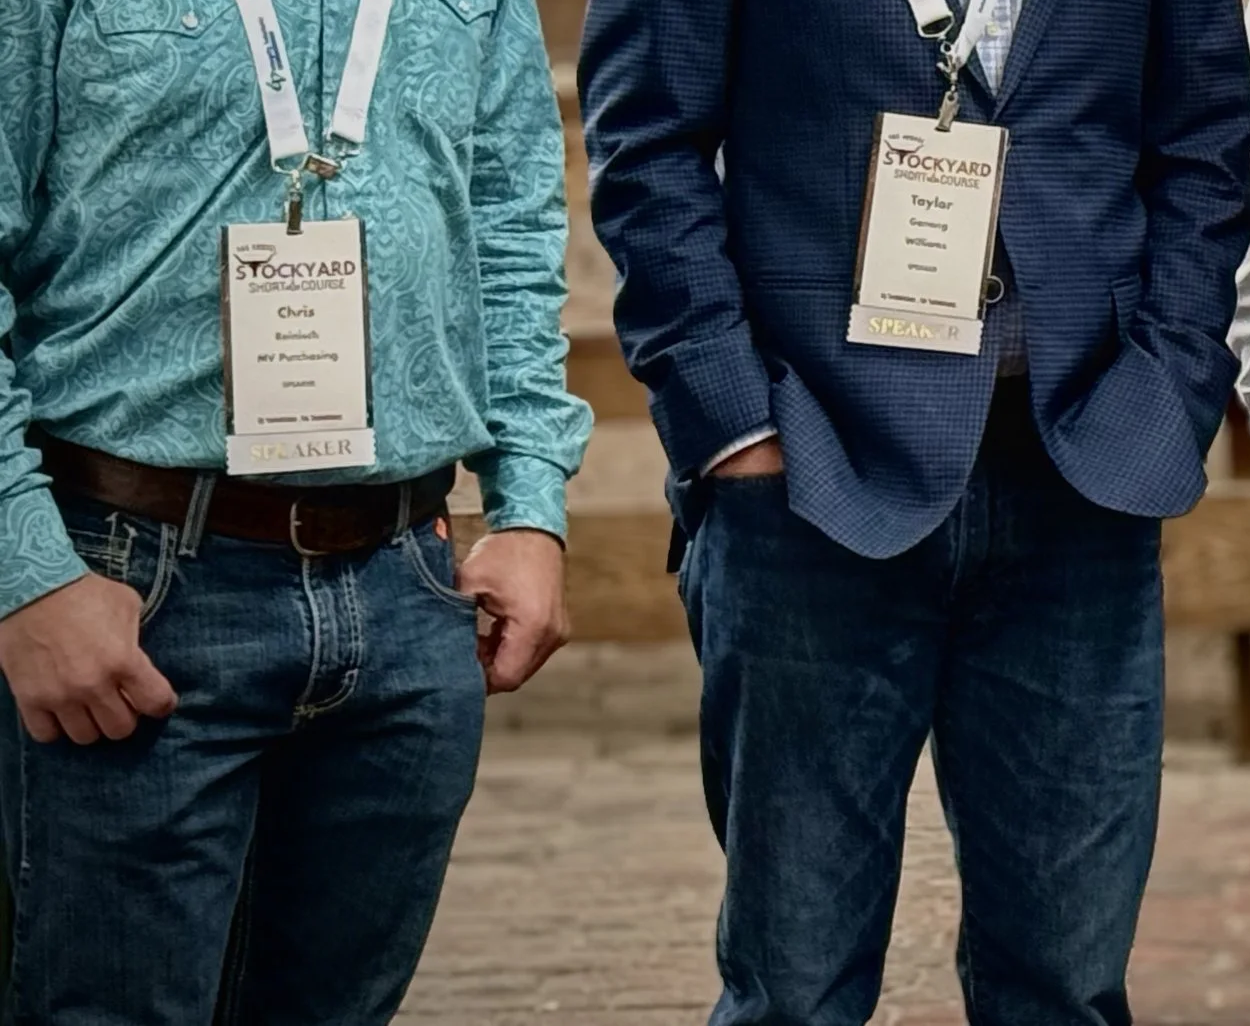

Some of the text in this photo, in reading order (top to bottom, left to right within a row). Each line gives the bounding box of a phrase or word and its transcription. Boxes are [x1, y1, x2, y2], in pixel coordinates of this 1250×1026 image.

[883, 151, 991, 178] STOCKYARD
[940, 174, 980, 189] COURSE
[911, 194, 953, 211] Taylor
[235, 260, 356, 281] STOCKYARD
[248, 279, 346, 294] SHORT COURSE
[278, 305, 315, 319] Chris
[868, 317, 960, 341] SPEAKR
[249, 438, 353, 462] SPEAKER
